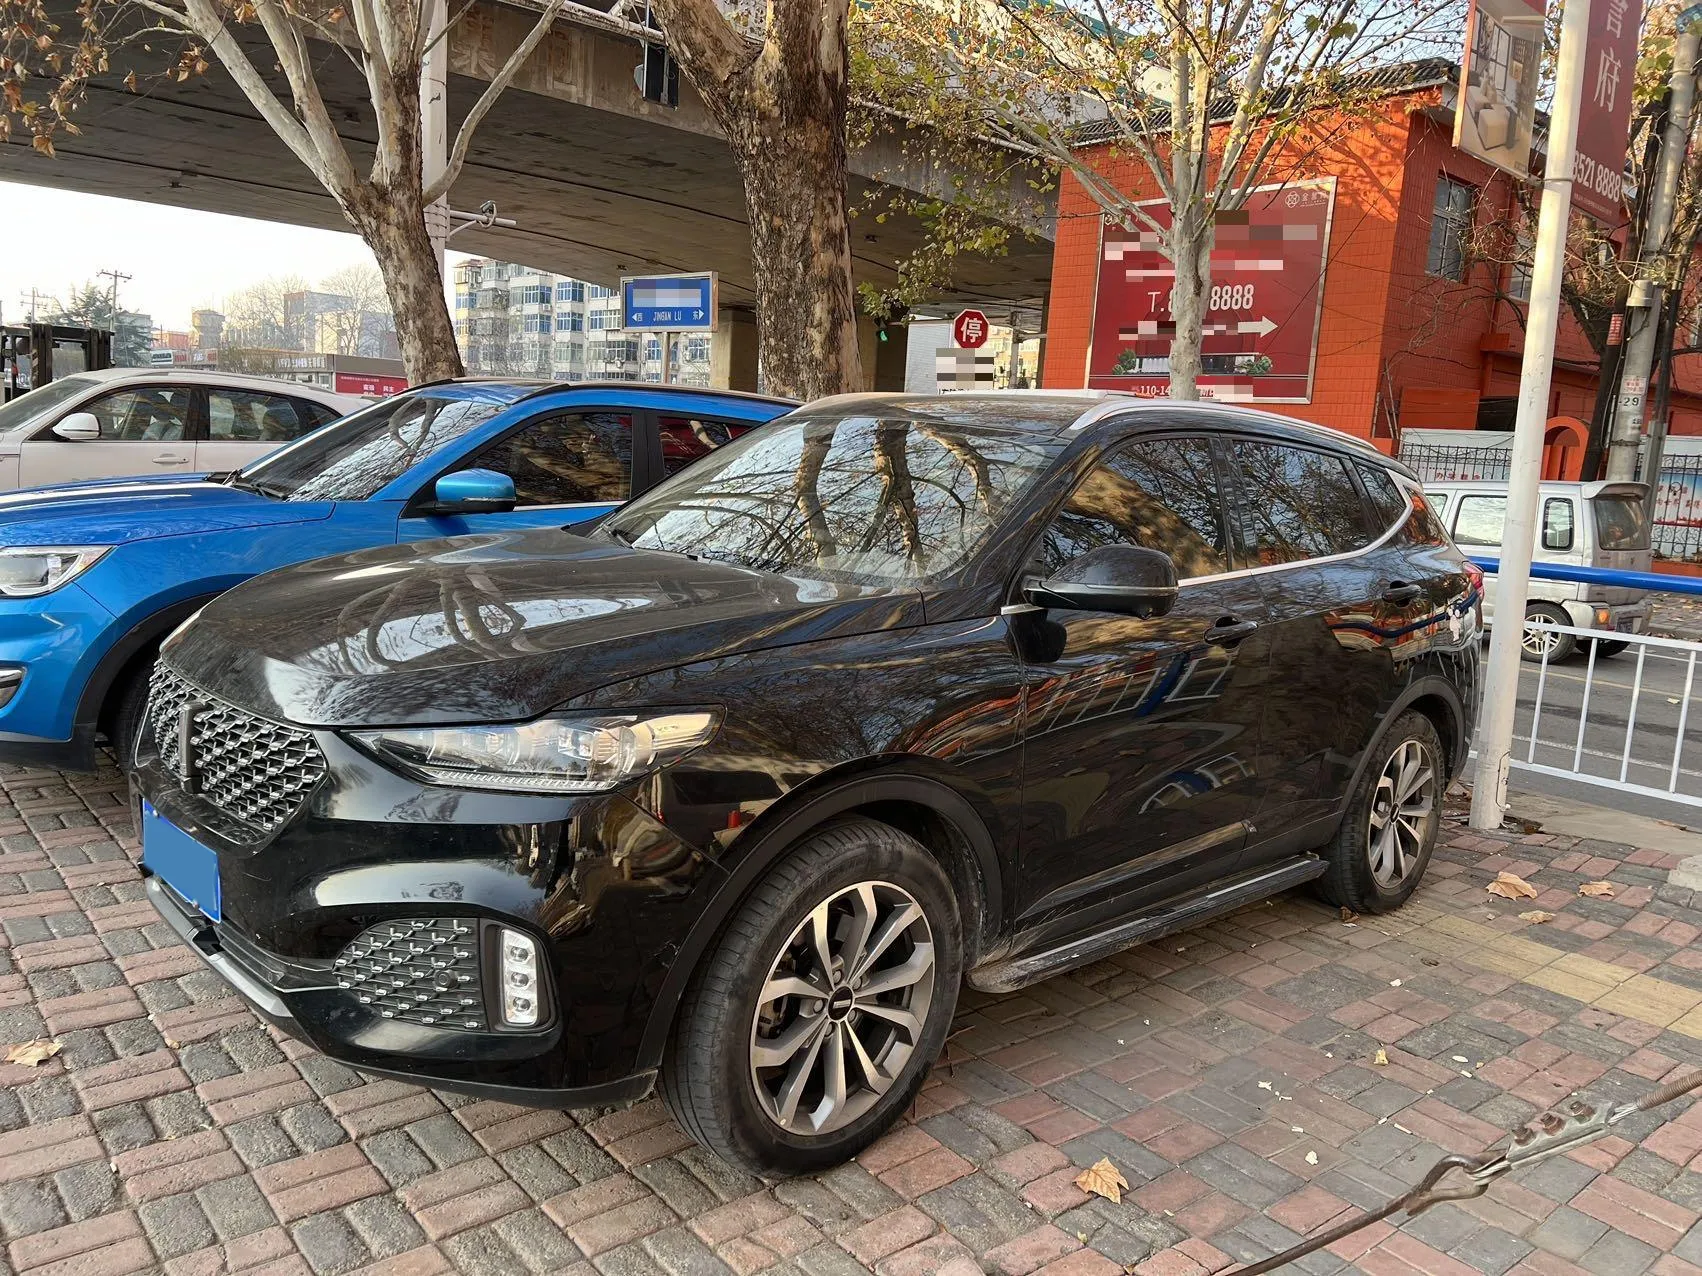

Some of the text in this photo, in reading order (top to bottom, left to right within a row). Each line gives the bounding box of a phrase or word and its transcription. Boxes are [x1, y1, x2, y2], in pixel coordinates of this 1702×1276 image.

[1595, 164, 1621, 202] 8888
[1210, 284, 1254, 311] 8888
[674, 310, 682, 321] LU
[960, 316, 983, 343] 停
